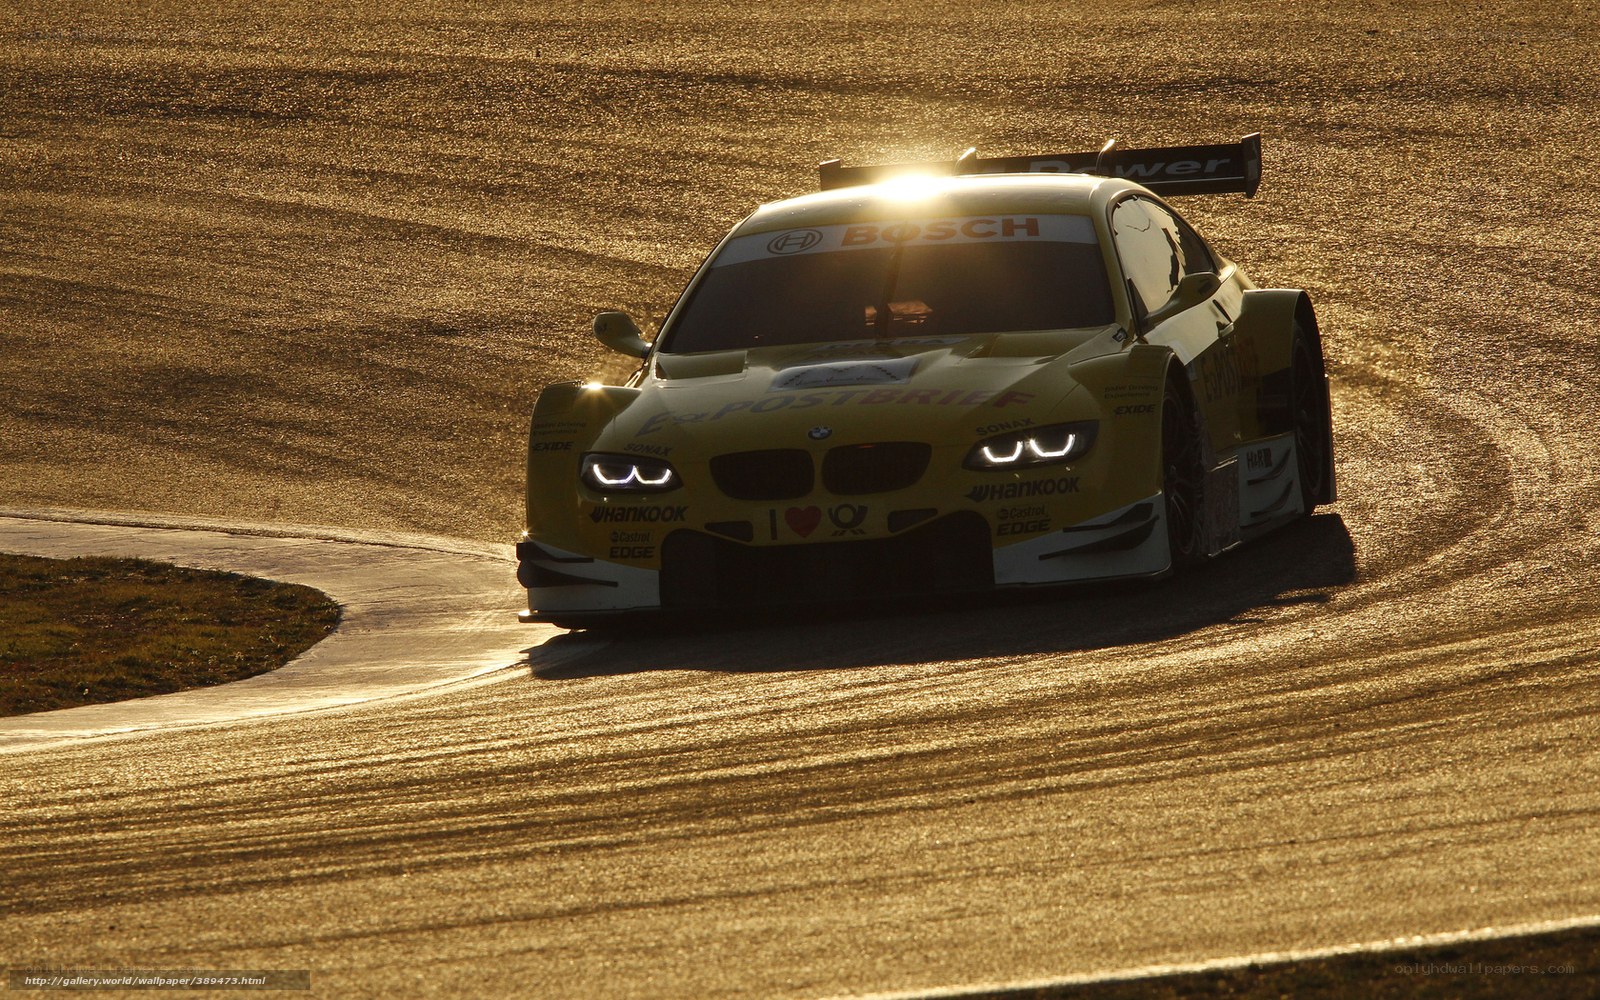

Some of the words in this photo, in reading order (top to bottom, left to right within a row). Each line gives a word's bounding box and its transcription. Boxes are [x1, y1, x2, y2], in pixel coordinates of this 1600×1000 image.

[841, 217, 1040, 247] BOSCH
[1115, 403, 1157, 415] EXIDE
[975, 417, 1037, 436] SONAX
[532, 441, 575, 451] EXIDE
[623, 442, 673, 457] SONAX
[1008, 504, 1046, 518] Castrol
[996, 518, 1052, 537] EDGE
[618, 530, 651, 543] Castrol
[608, 546, 656, 559] EDGE
